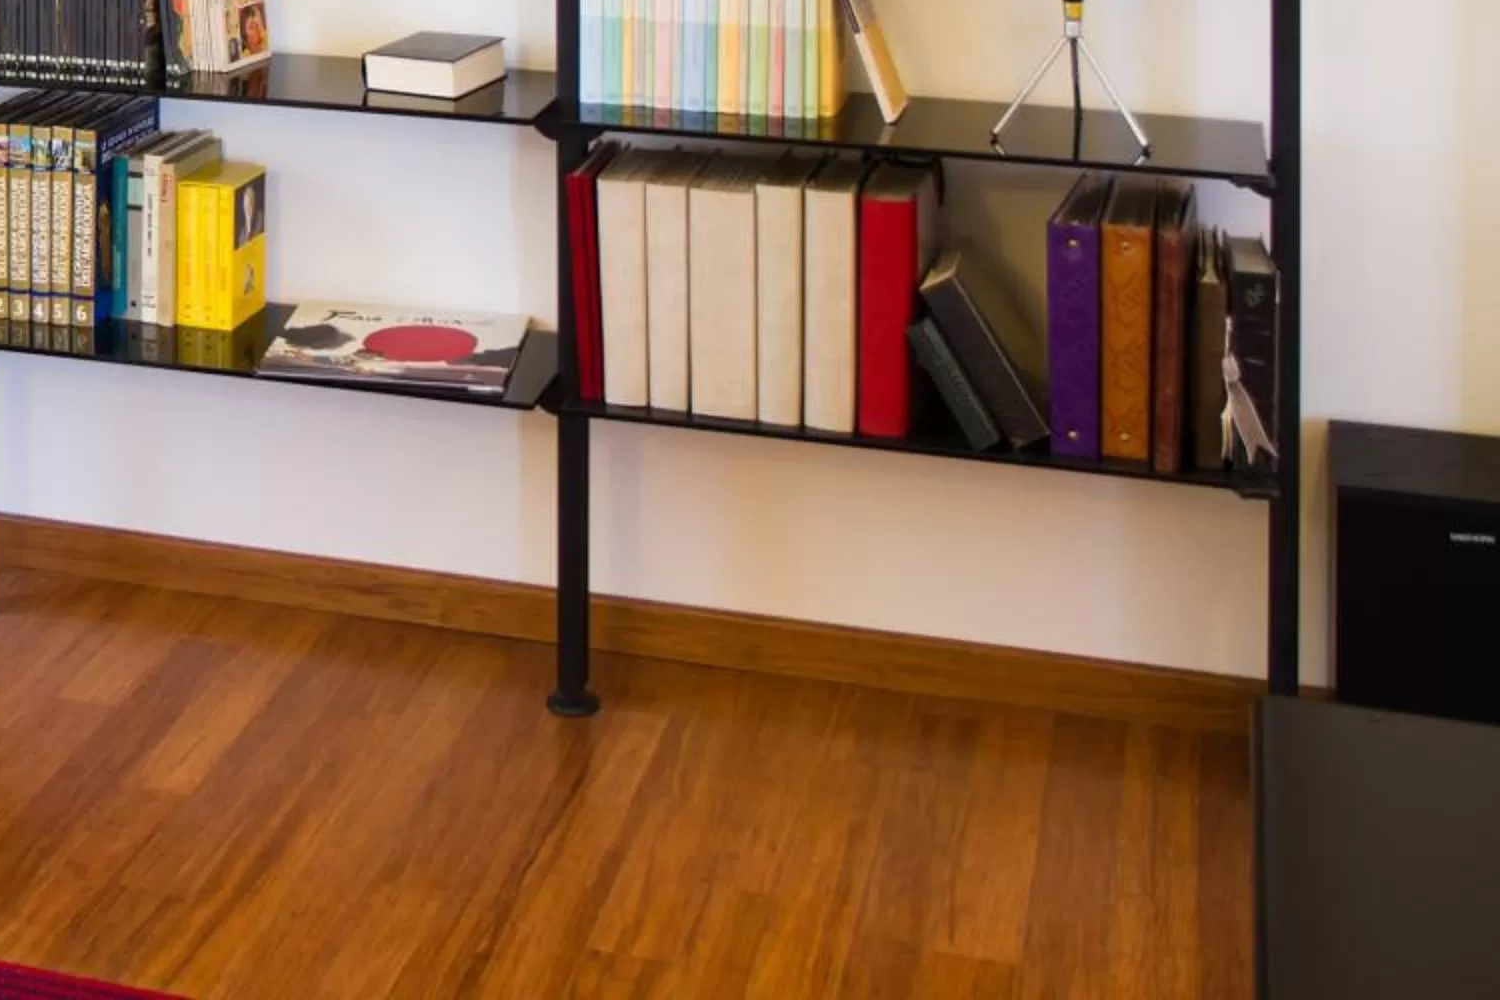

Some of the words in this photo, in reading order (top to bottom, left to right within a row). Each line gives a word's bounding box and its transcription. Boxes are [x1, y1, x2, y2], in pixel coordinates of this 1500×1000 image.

[13, 301, 24, 315] 3
[34, 303, 44, 317] 4
[52, 304, 62, 319] 5
[76, 305, 87, 321] 6
